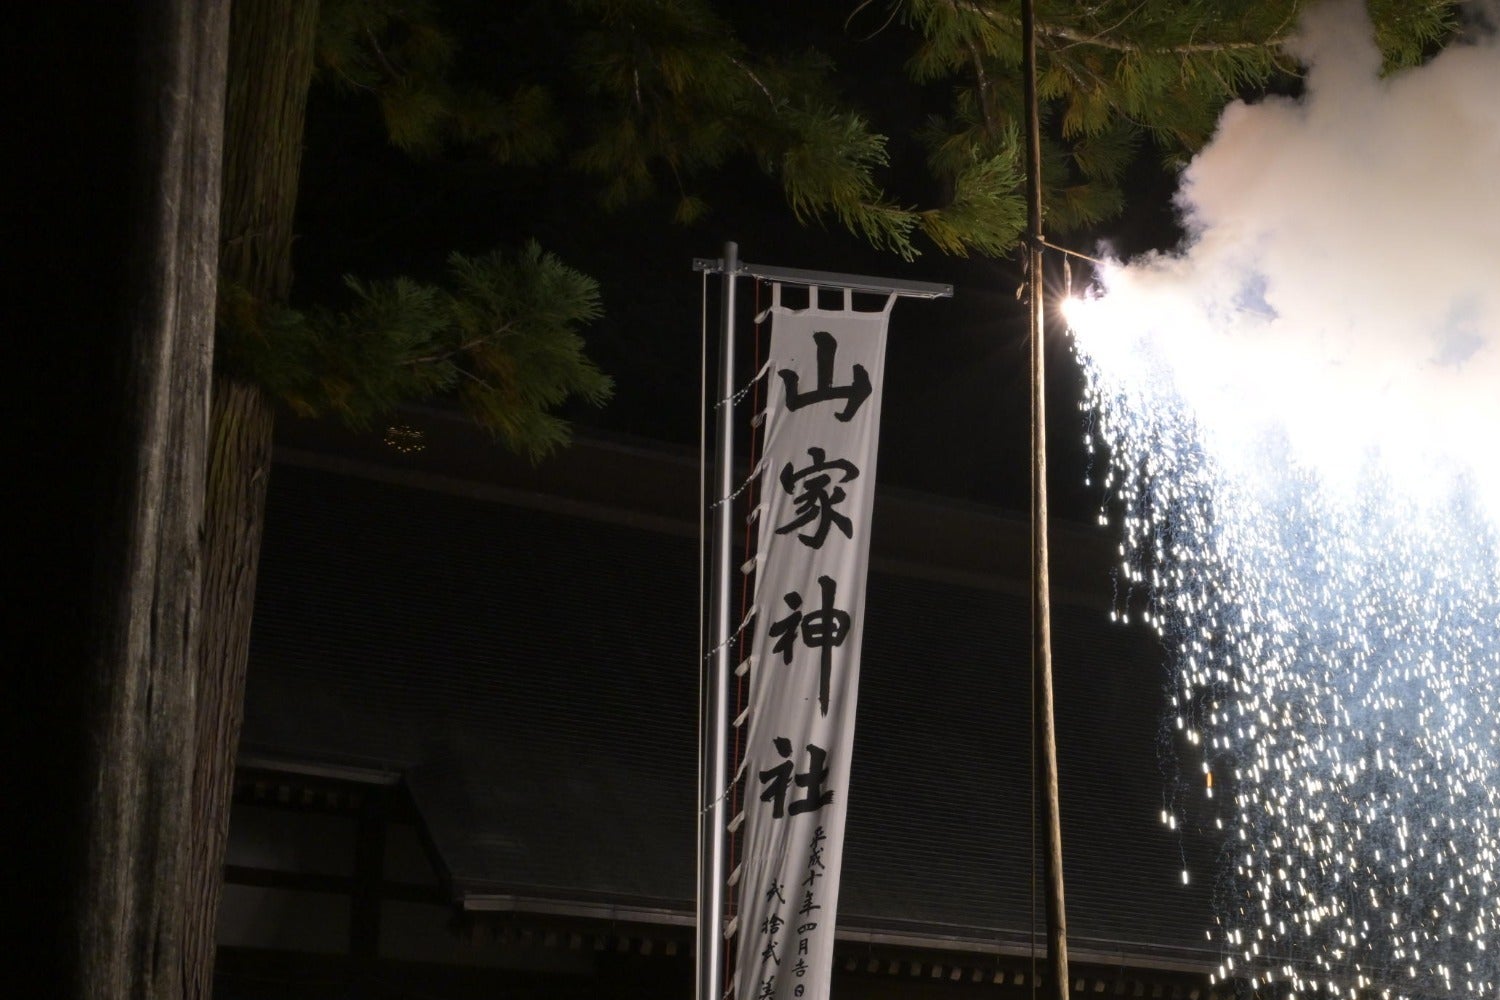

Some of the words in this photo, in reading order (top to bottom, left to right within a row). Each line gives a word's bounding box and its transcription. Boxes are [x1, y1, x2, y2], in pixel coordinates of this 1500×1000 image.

[758, 331, 873, 819] 山家神社
[791, 825, 826, 998] 平成十年四月吉日
